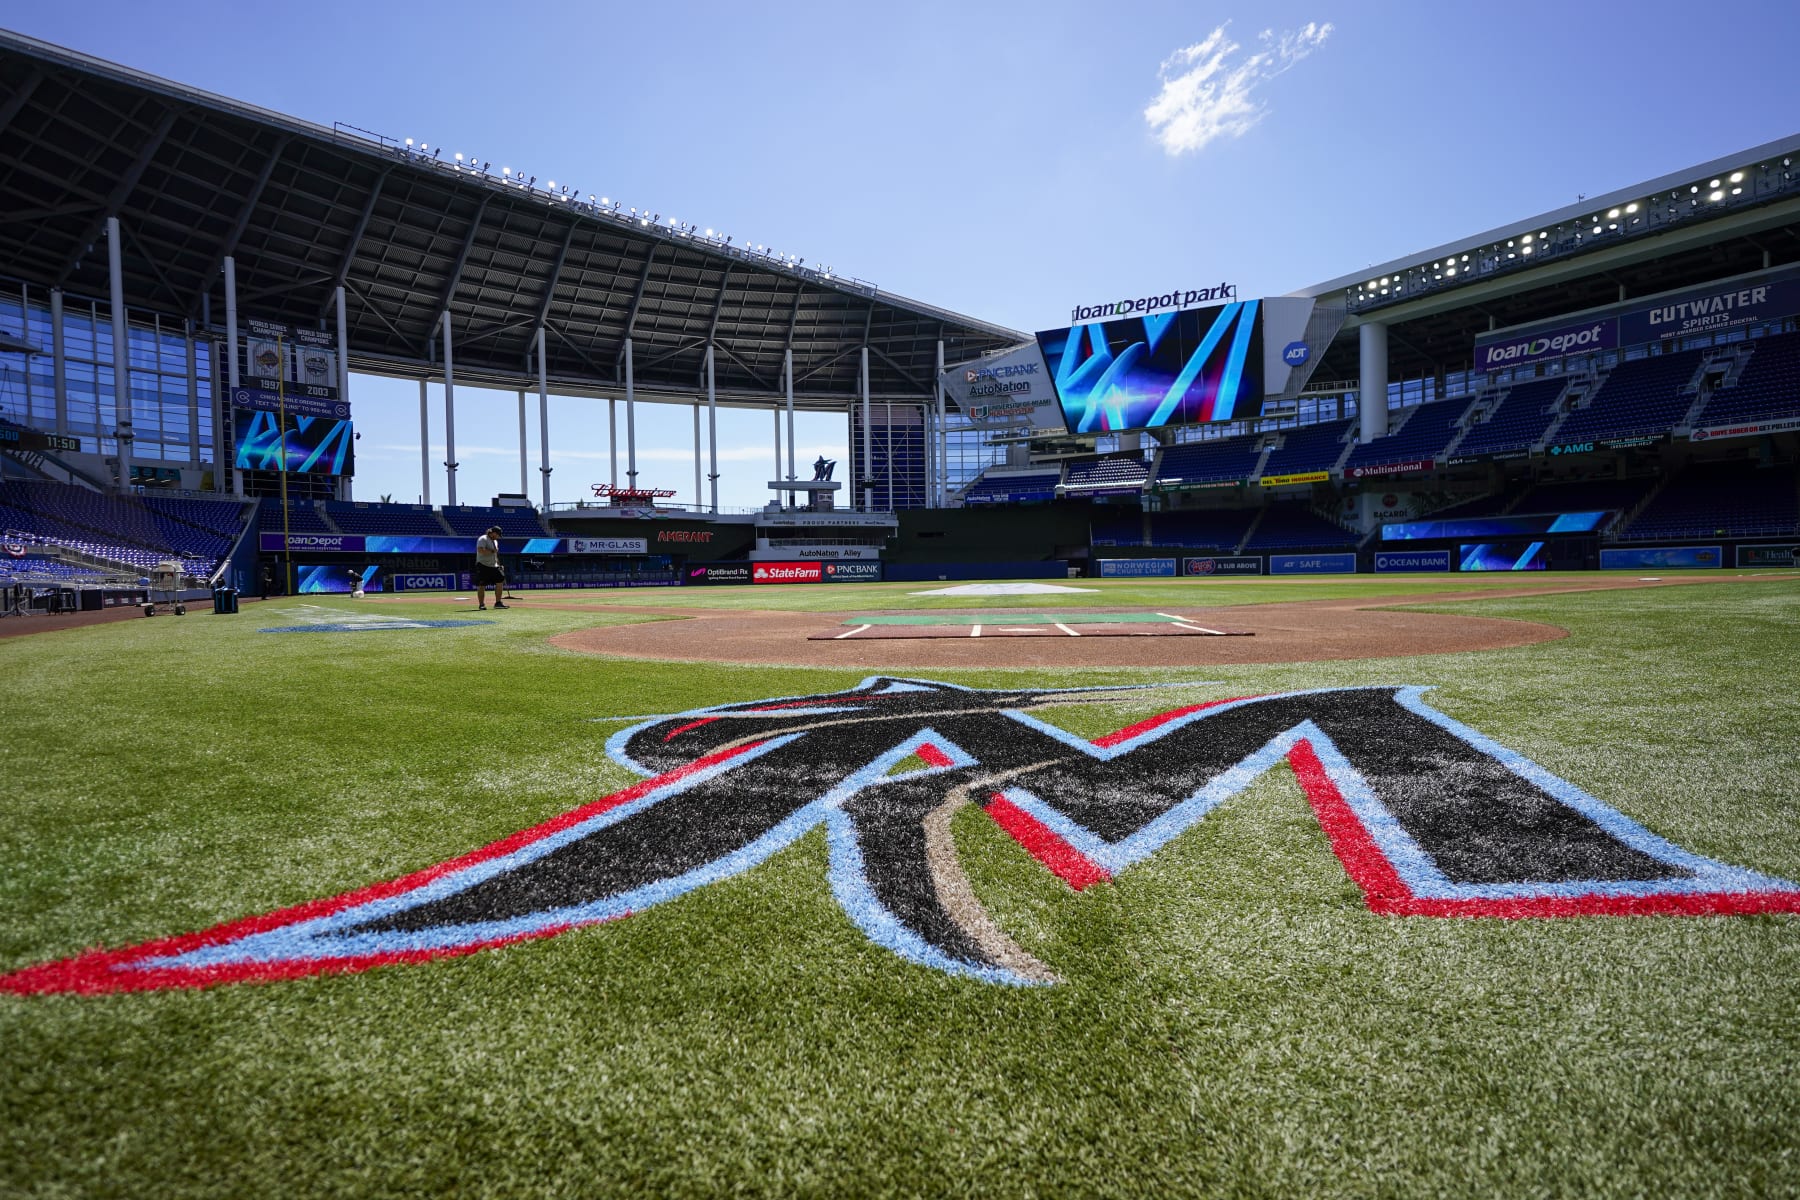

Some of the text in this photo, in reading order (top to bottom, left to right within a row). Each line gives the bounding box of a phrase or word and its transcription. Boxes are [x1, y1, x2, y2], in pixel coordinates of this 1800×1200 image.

[1075, 282, 1232, 320] loanDepot park
[1649, 286, 1766, 324] CUTWATER
[248, 320, 287, 332] WORLD SERIES
[1682, 312, 1730, 328] SPIRITS
[300, 335, 330, 344] CHAMPIONS
[1486, 324, 1602, 363] loanDepot
[1286, 348, 1307, 359] ADT
[1006, 363, 1038, 377] BANK
[260, 380, 280, 390] 1997
[970, 381, 1030, 395] AutoNation
[307, 386, 328, 397] 2003
[47, 436, 76, 449] 11:50
[1563, 442, 1594, 454] AMG
[1365, 462, 1422, 475] Multinational
[590, 483, 677, 498] Budweiser
[285, 536, 342, 546] oanDepot
[658, 530, 712, 542] AMERANT
[856, 565, 878, 573] BANK
[407, 577, 444, 588] GOYA
